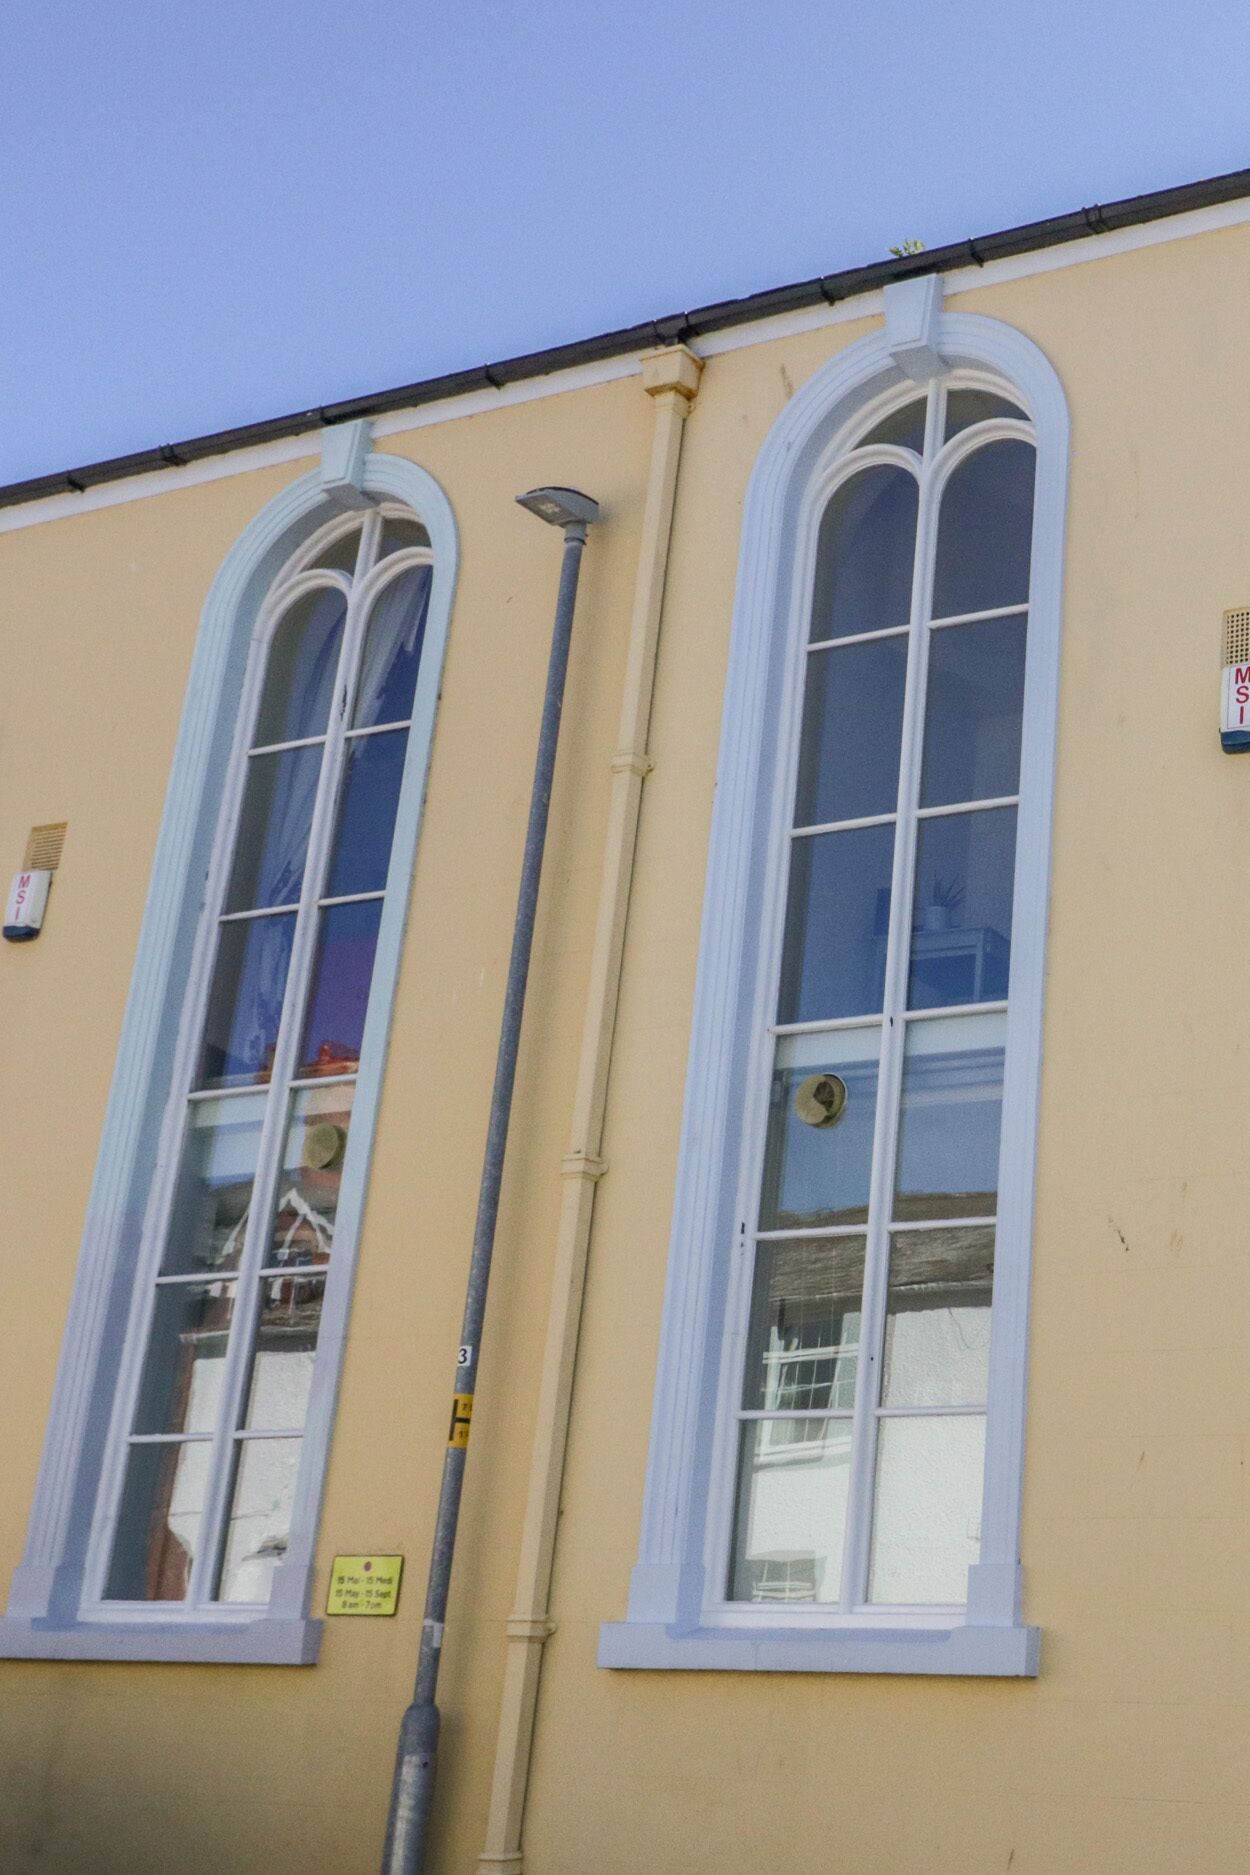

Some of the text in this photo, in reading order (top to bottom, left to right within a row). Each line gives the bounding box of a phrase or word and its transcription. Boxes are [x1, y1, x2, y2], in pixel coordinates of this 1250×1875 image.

[15, 874, 31, 921] MSI
[458, 1348, 468, 1364] 3
[345, 1589, 359, 1599] May
[374, 1589, 391, 1598] Sept
